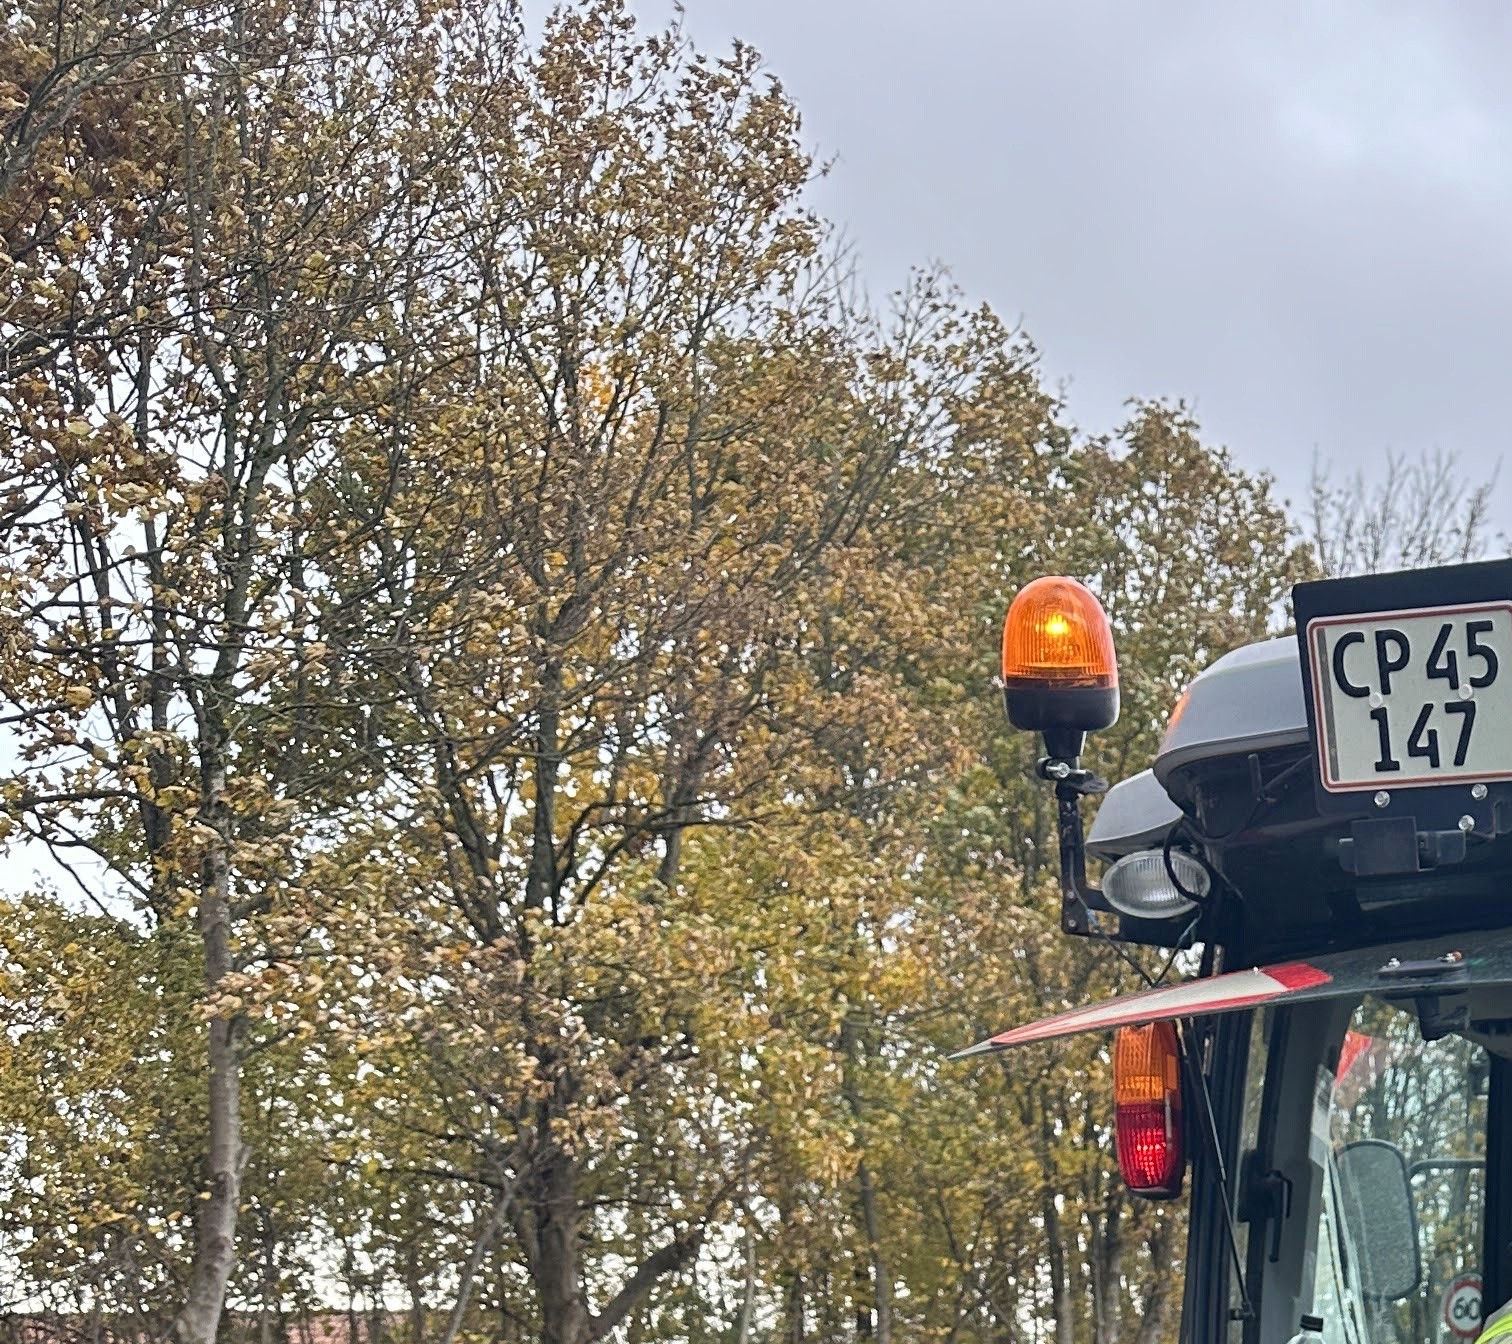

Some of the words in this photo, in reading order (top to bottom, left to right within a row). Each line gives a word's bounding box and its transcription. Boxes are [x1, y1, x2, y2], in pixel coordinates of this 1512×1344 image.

[1333, 629, 1411, 698] CP
[1426, 620, 1499, 690] 45
[1370, 700, 1476, 772] 147
